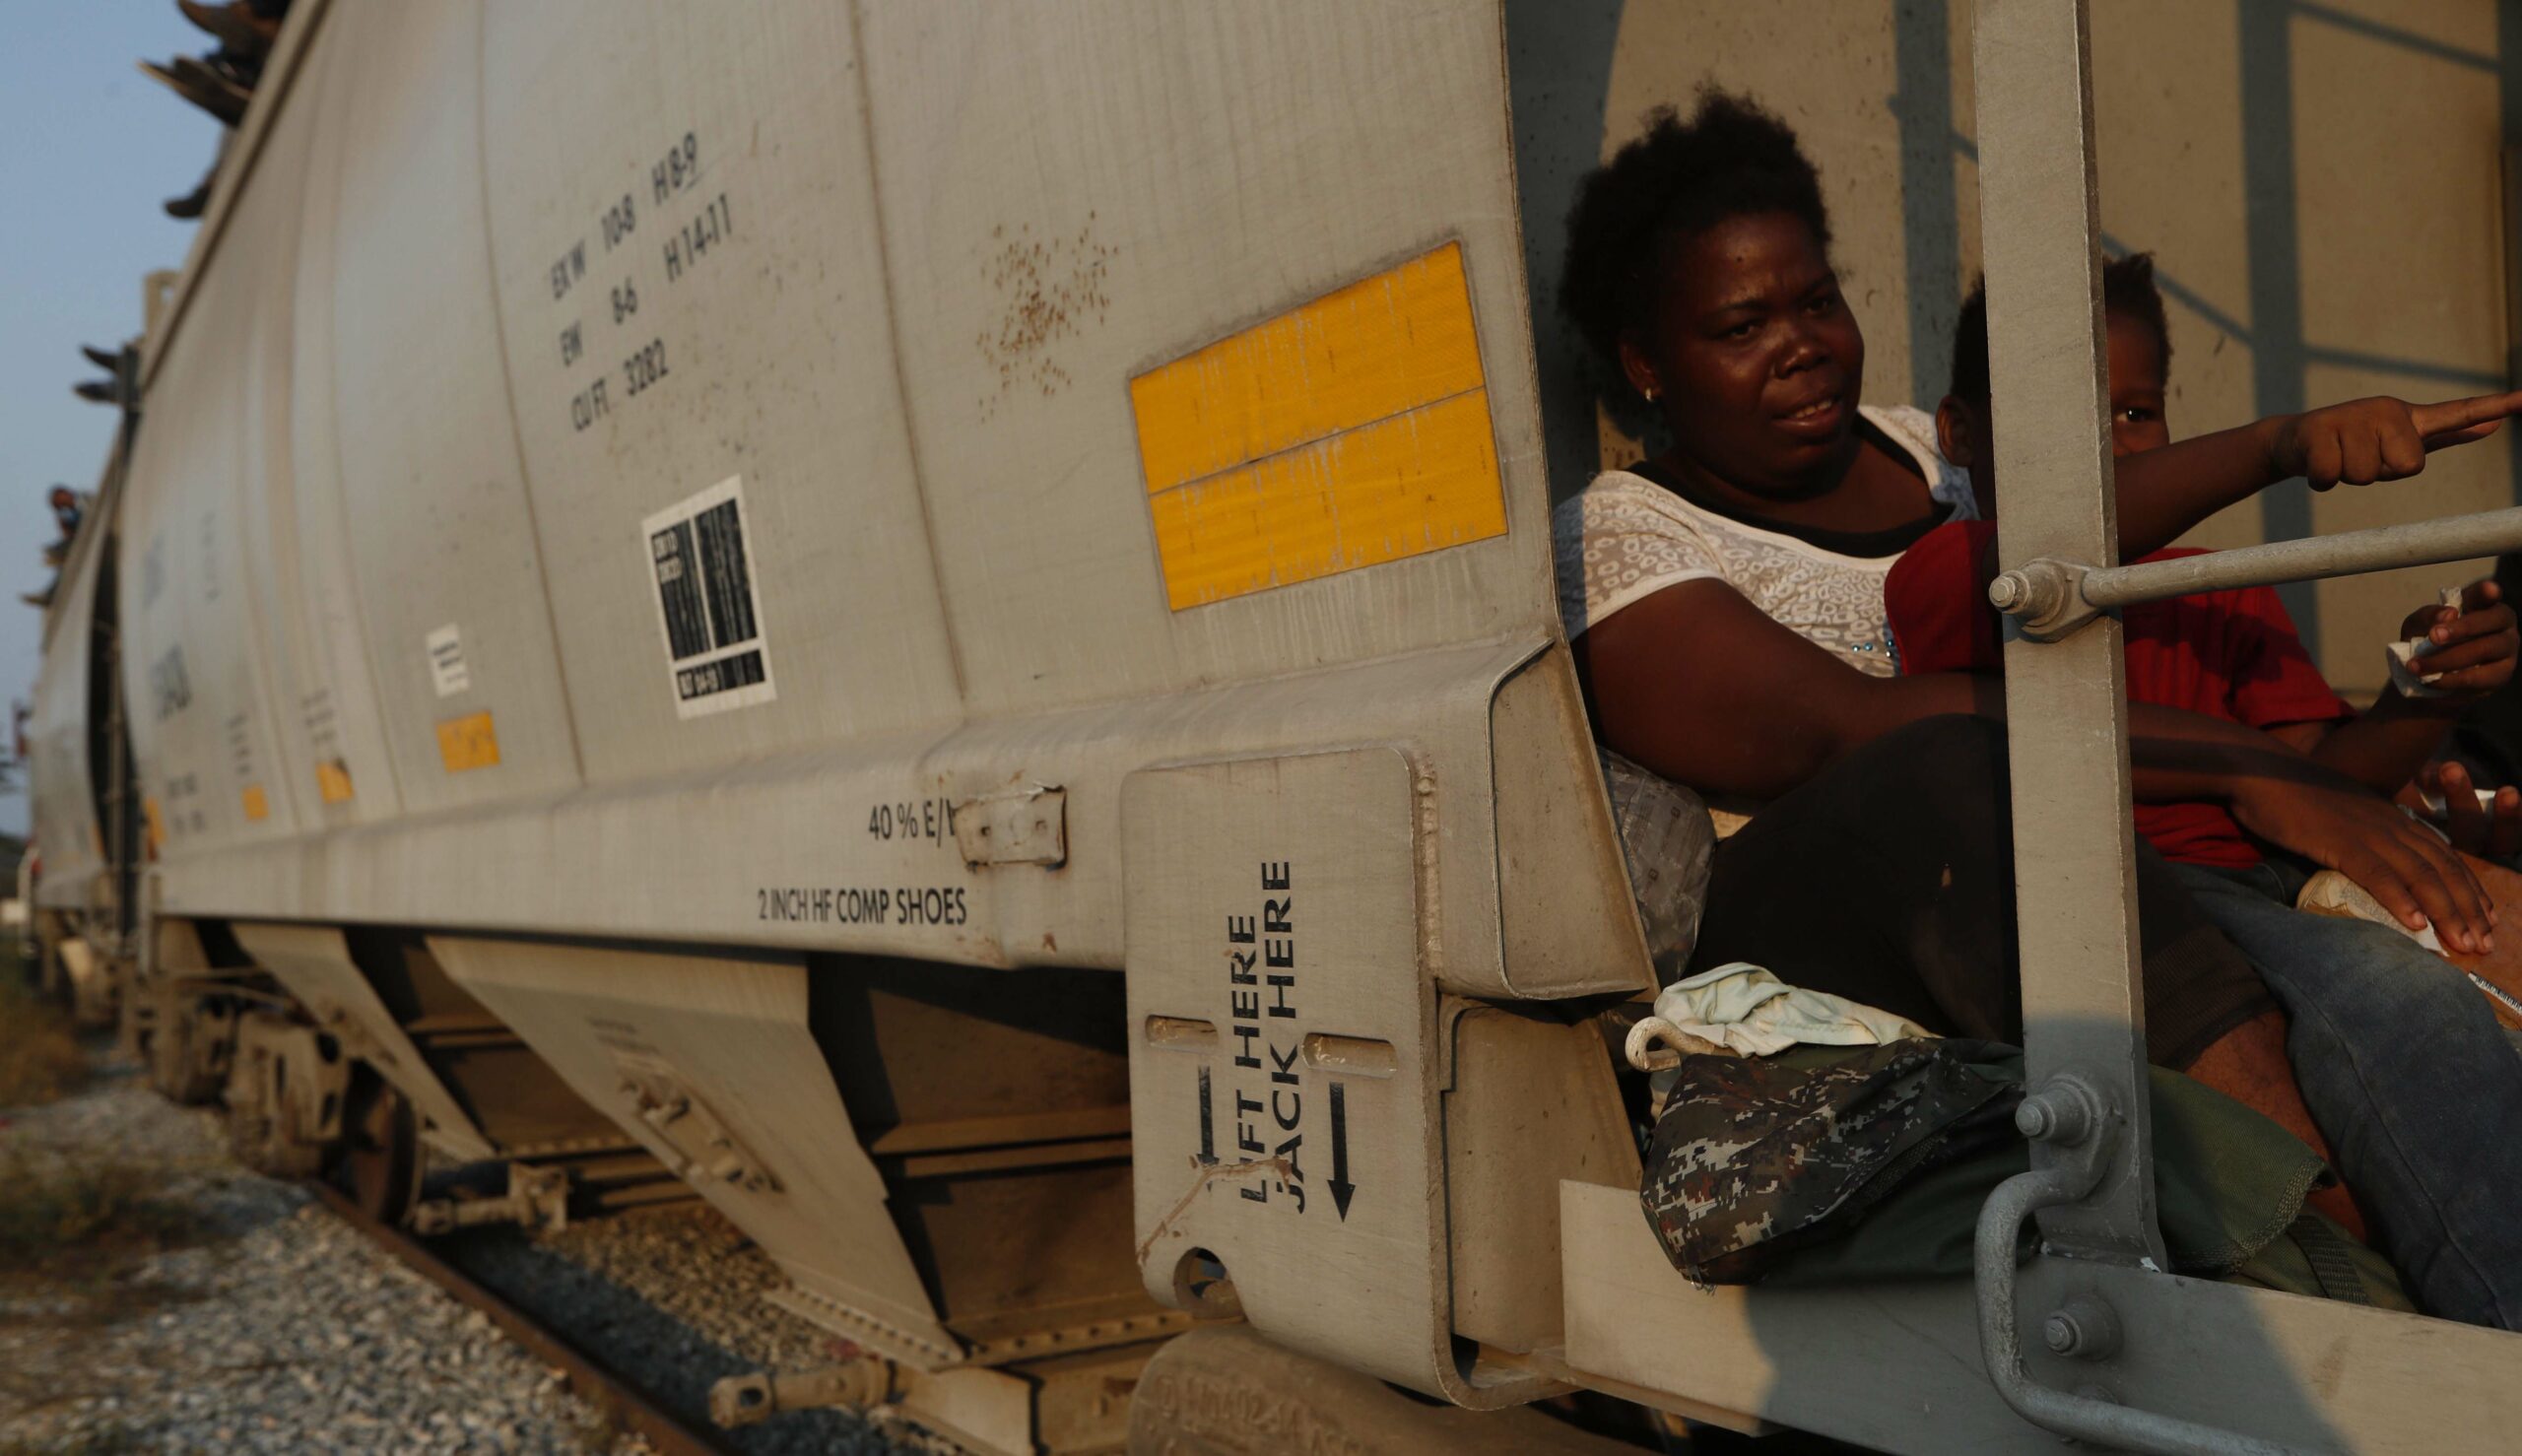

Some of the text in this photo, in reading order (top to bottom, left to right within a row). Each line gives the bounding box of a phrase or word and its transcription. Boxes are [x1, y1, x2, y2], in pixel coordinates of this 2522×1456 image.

[624, 337, 669, 397] 3282
[869, 804, 893, 840] 40
[758, 887, 967, 925] 2 INCH HF COMP SHOES
[1228, 915, 1268, 1203] LFT HERE
[1261, 861, 1305, 1215] JACK HERE
